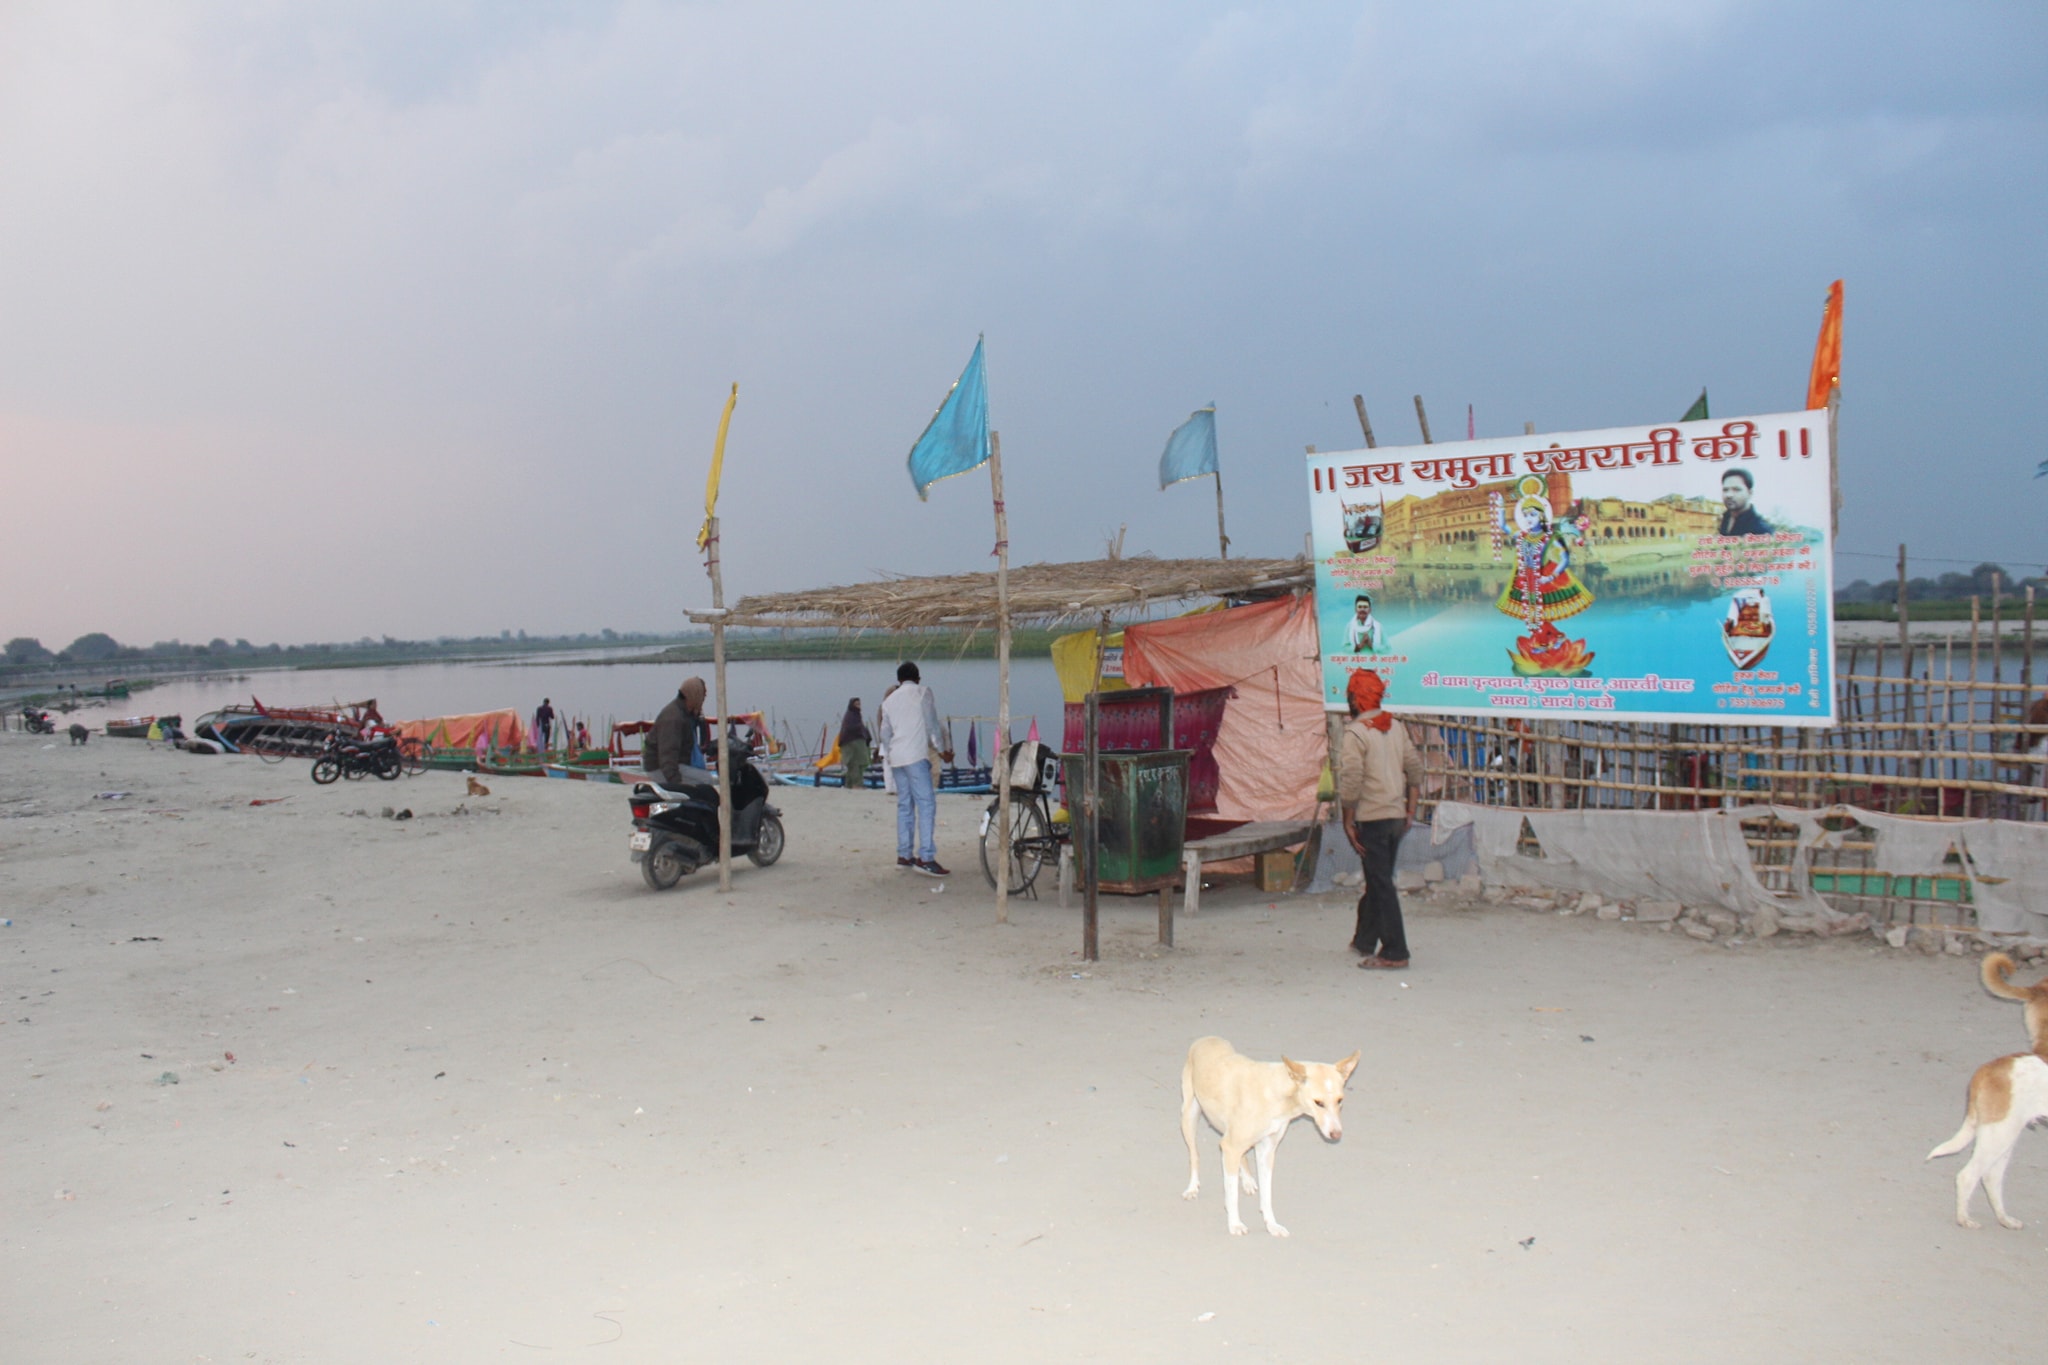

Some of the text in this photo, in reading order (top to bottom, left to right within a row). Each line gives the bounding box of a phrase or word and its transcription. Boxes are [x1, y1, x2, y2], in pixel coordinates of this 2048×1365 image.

[1342, 462, 1403, 488] जय
[1411, 453, 1514, 489] यमुना
[1691, 420, 1760, 460] की
[1422, 671, 1439, 687] श्री
[1442, 676, 1469, 687] धाम
[1661, 679, 1696, 692] घाट
[1490, 695, 1528, 706] समय
[1576, 696, 1586, 708] 6
